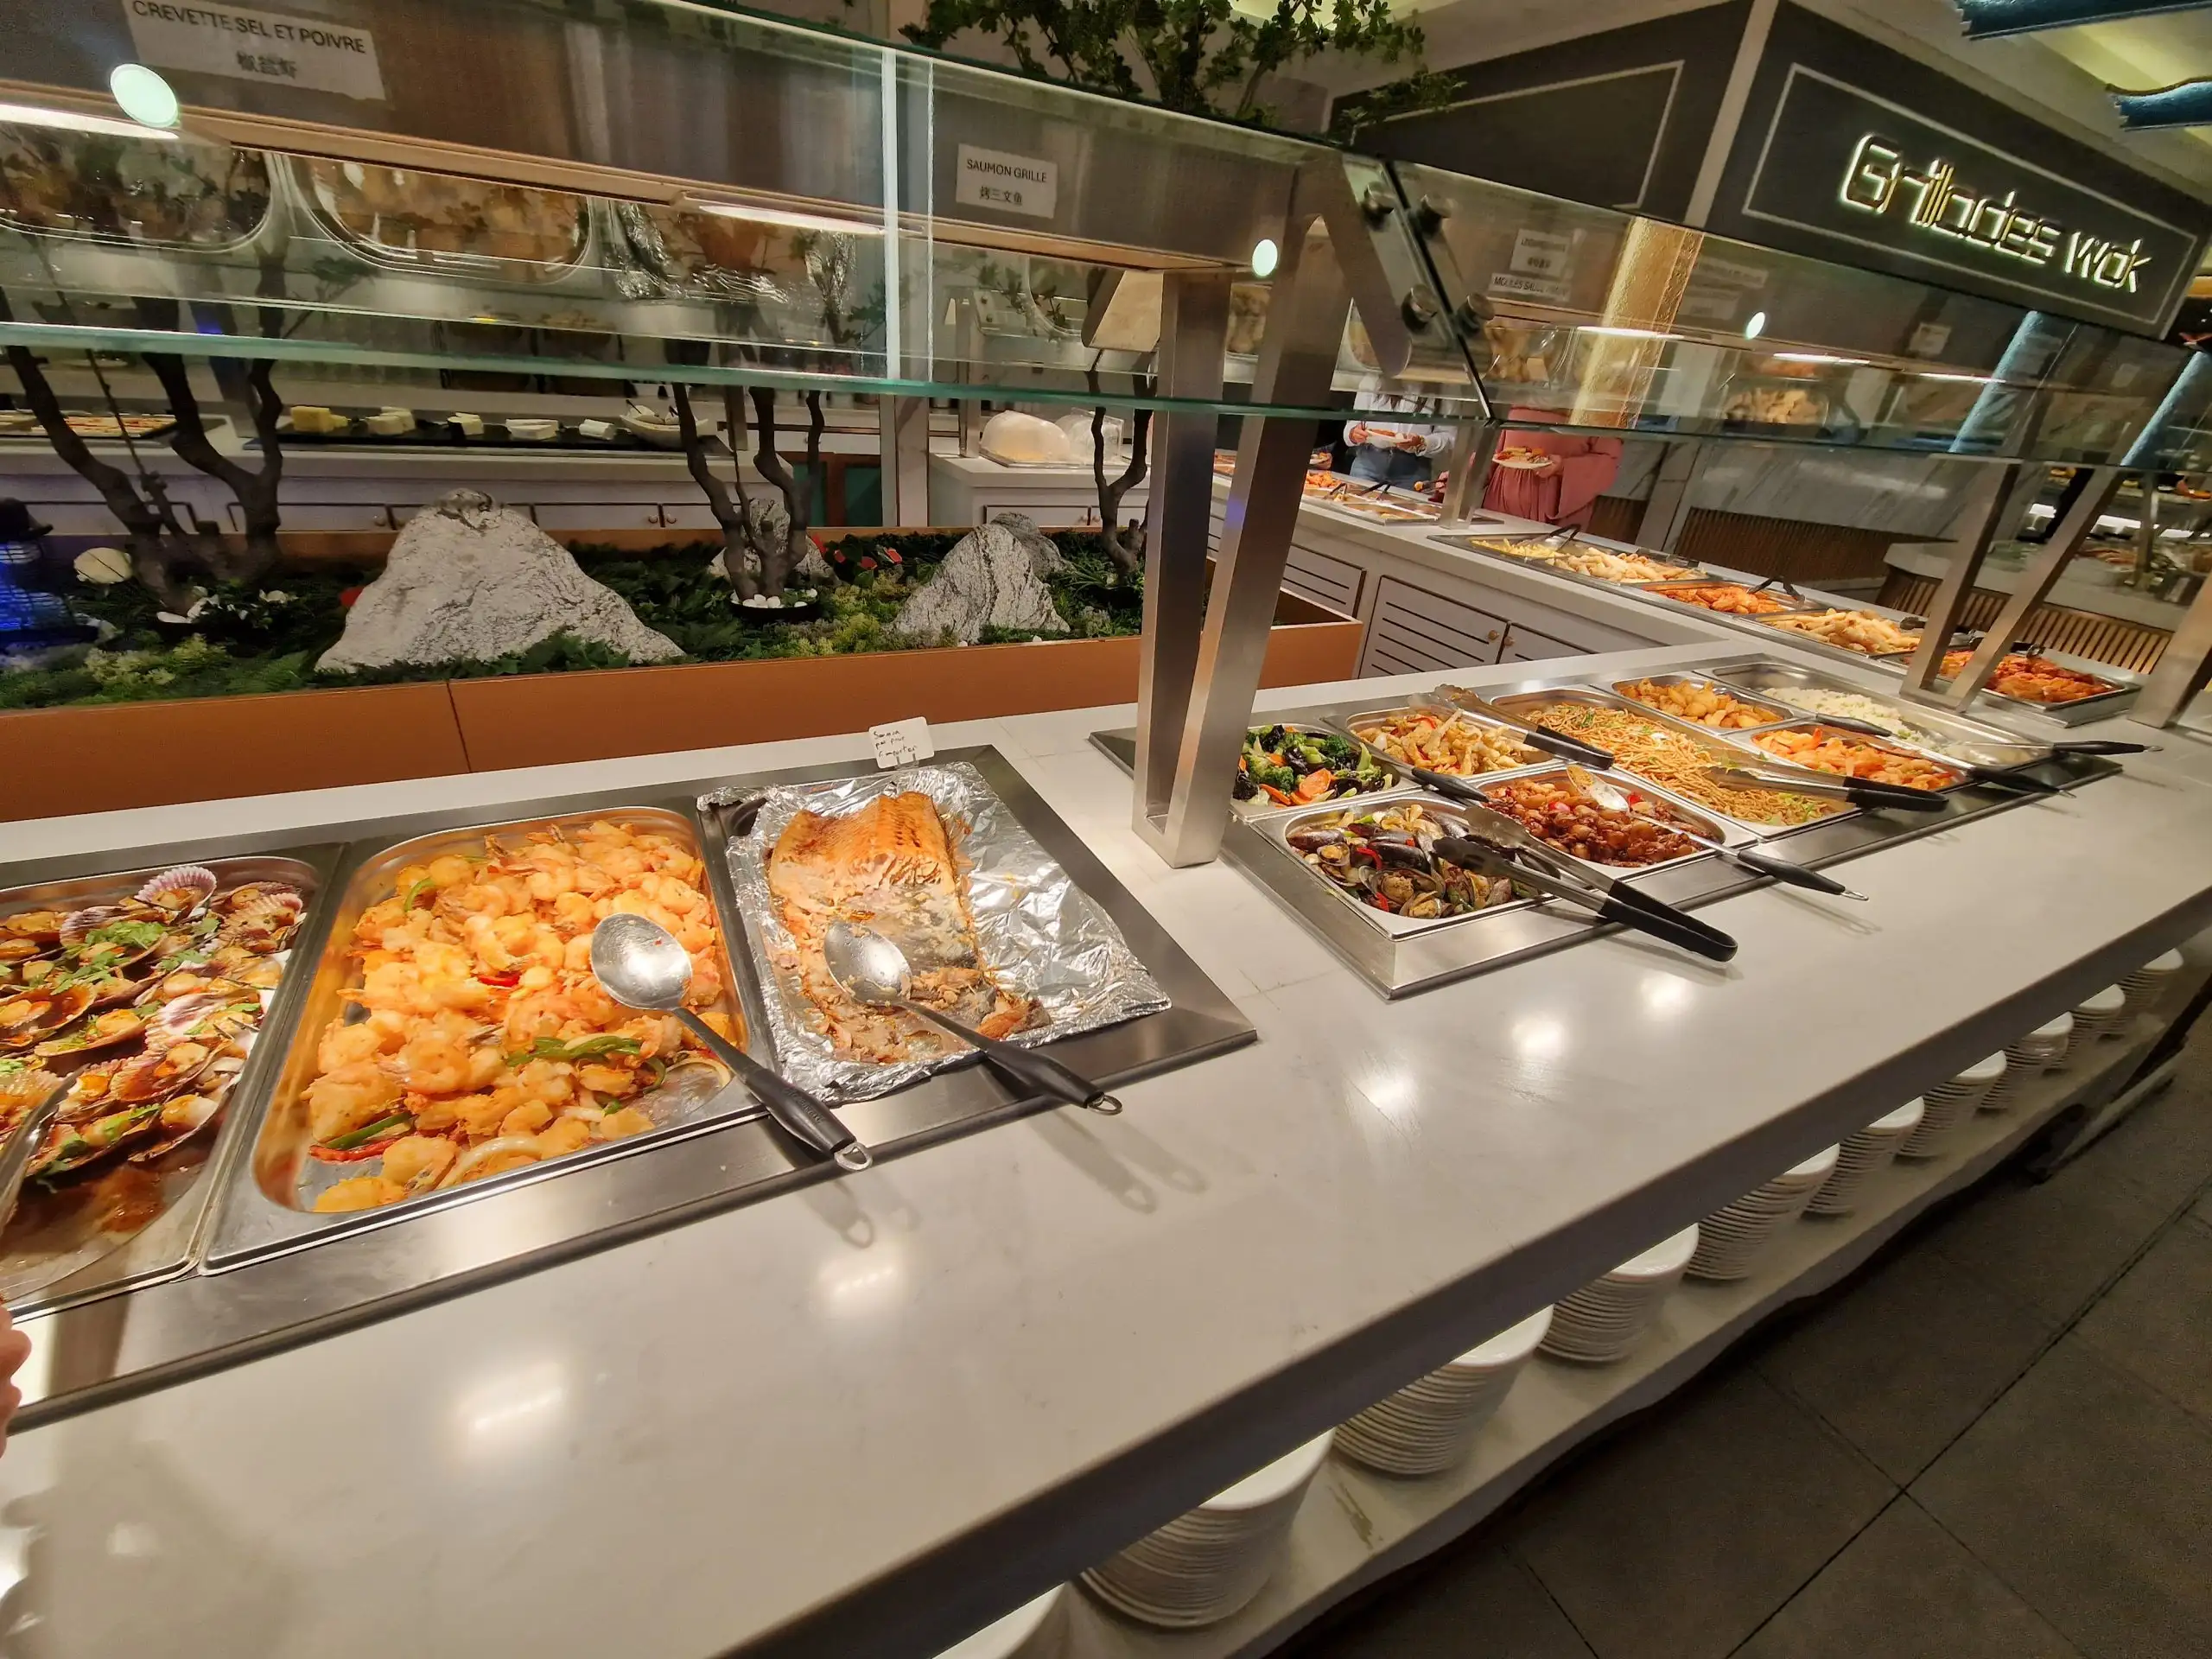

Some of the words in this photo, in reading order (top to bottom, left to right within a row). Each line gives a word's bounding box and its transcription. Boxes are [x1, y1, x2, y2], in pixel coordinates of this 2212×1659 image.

[132, 1, 233, 31] CREVETTE
[235, 16, 271, 38] SEL
[275, 24, 299, 41] ET
[300, 29, 366, 54] POIVRE
[967, 159, 1012, 177] SAUMON
[1014, 167, 1047, 183] GRILLE
[1840, 132, 2063, 264] Grillades
